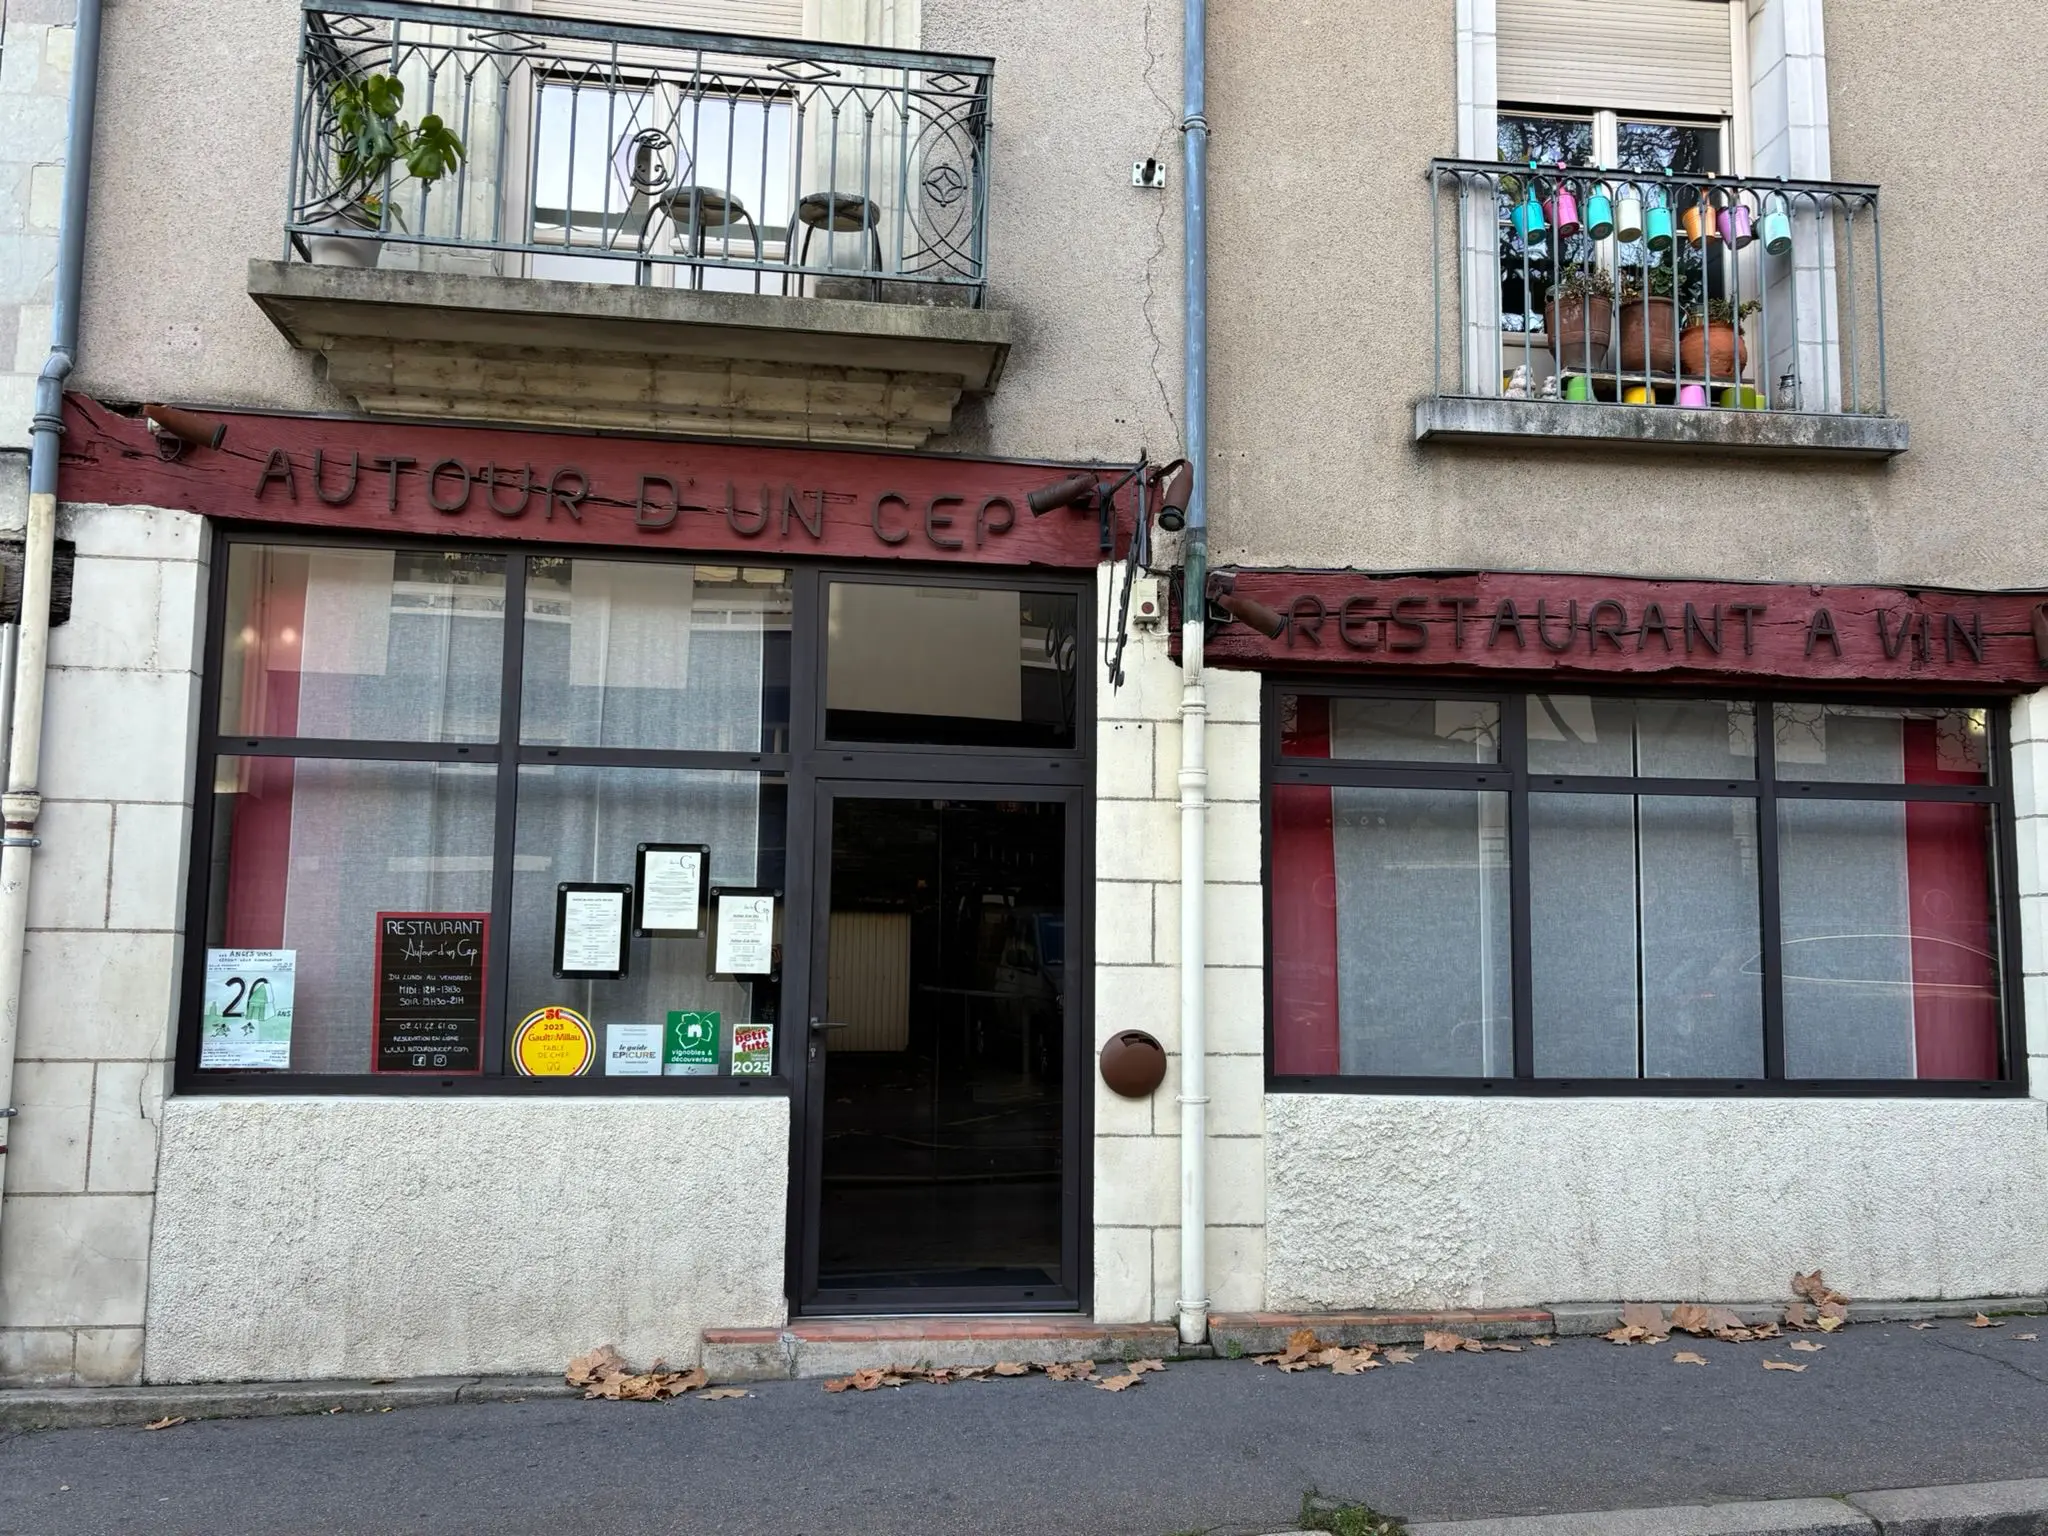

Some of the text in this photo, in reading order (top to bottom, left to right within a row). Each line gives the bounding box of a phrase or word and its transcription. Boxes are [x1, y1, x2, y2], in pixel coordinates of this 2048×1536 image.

[254, 446, 589, 520] AUTOUR
[871, 490, 1016, 549] CEP
[1286, 594, 1768, 656] RESTAURANT
[1876, 608, 1984, 663] VIN
[386, 920, 483, 936] RESTAURANT
[612, 1051, 657, 1059] EPICURE
[671, 1049, 706, 1057] vignobles
[733, 1061, 770, 1074] 2025
